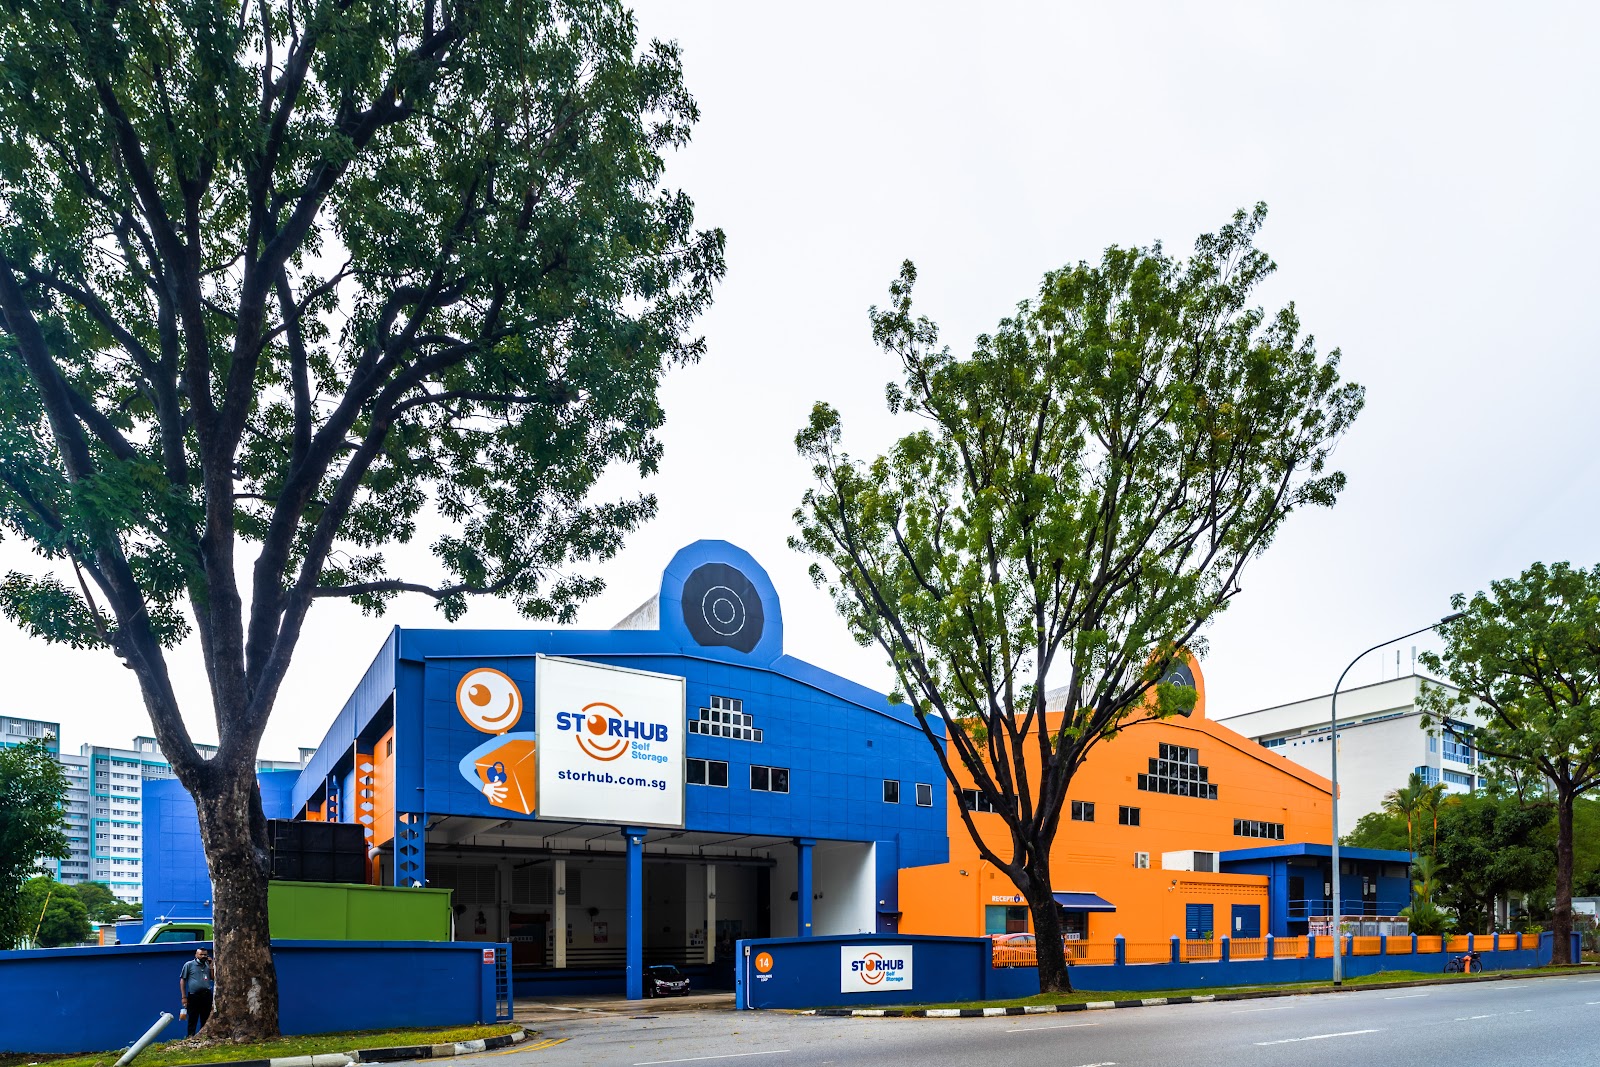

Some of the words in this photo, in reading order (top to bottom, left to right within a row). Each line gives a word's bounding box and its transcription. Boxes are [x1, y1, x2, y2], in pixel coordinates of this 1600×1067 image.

[556, 711, 668, 742] STORHUB
[631, 741, 650, 751] Self
[631, 750, 668, 763] Storage
[558, 769, 667, 791] storhub.com.sg
[759, 957, 769, 968] 14
[851, 959, 904, 971] STORHUB
